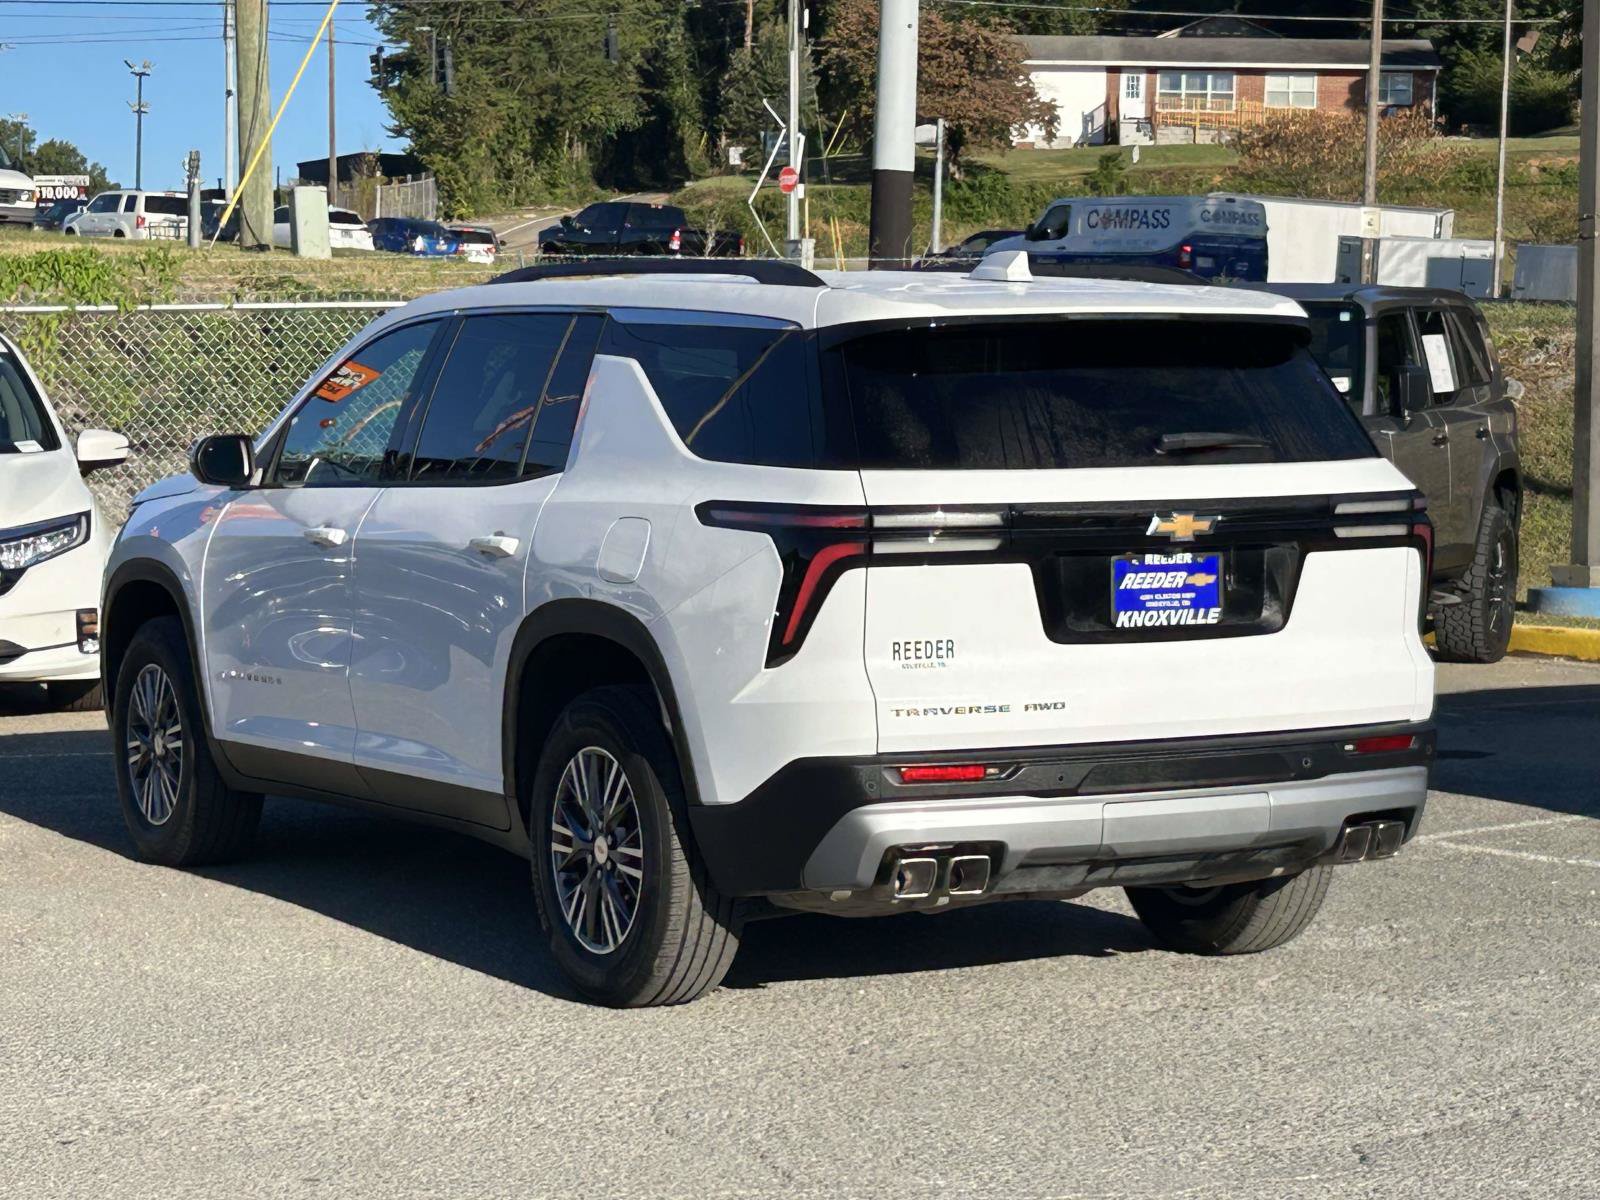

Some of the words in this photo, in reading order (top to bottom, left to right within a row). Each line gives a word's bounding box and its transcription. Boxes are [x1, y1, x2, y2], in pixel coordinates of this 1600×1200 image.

[1087, 208, 1170, 230] COMPASS
[1119, 571, 1188, 590] REEDER
[1115, 607, 1222, 628] KNOXVILLE
[892, 639, 955, 661] REEDER
[890, 704, 1011, 718] TRAVERSE
[1023, 701, 1066, 713] AWD
